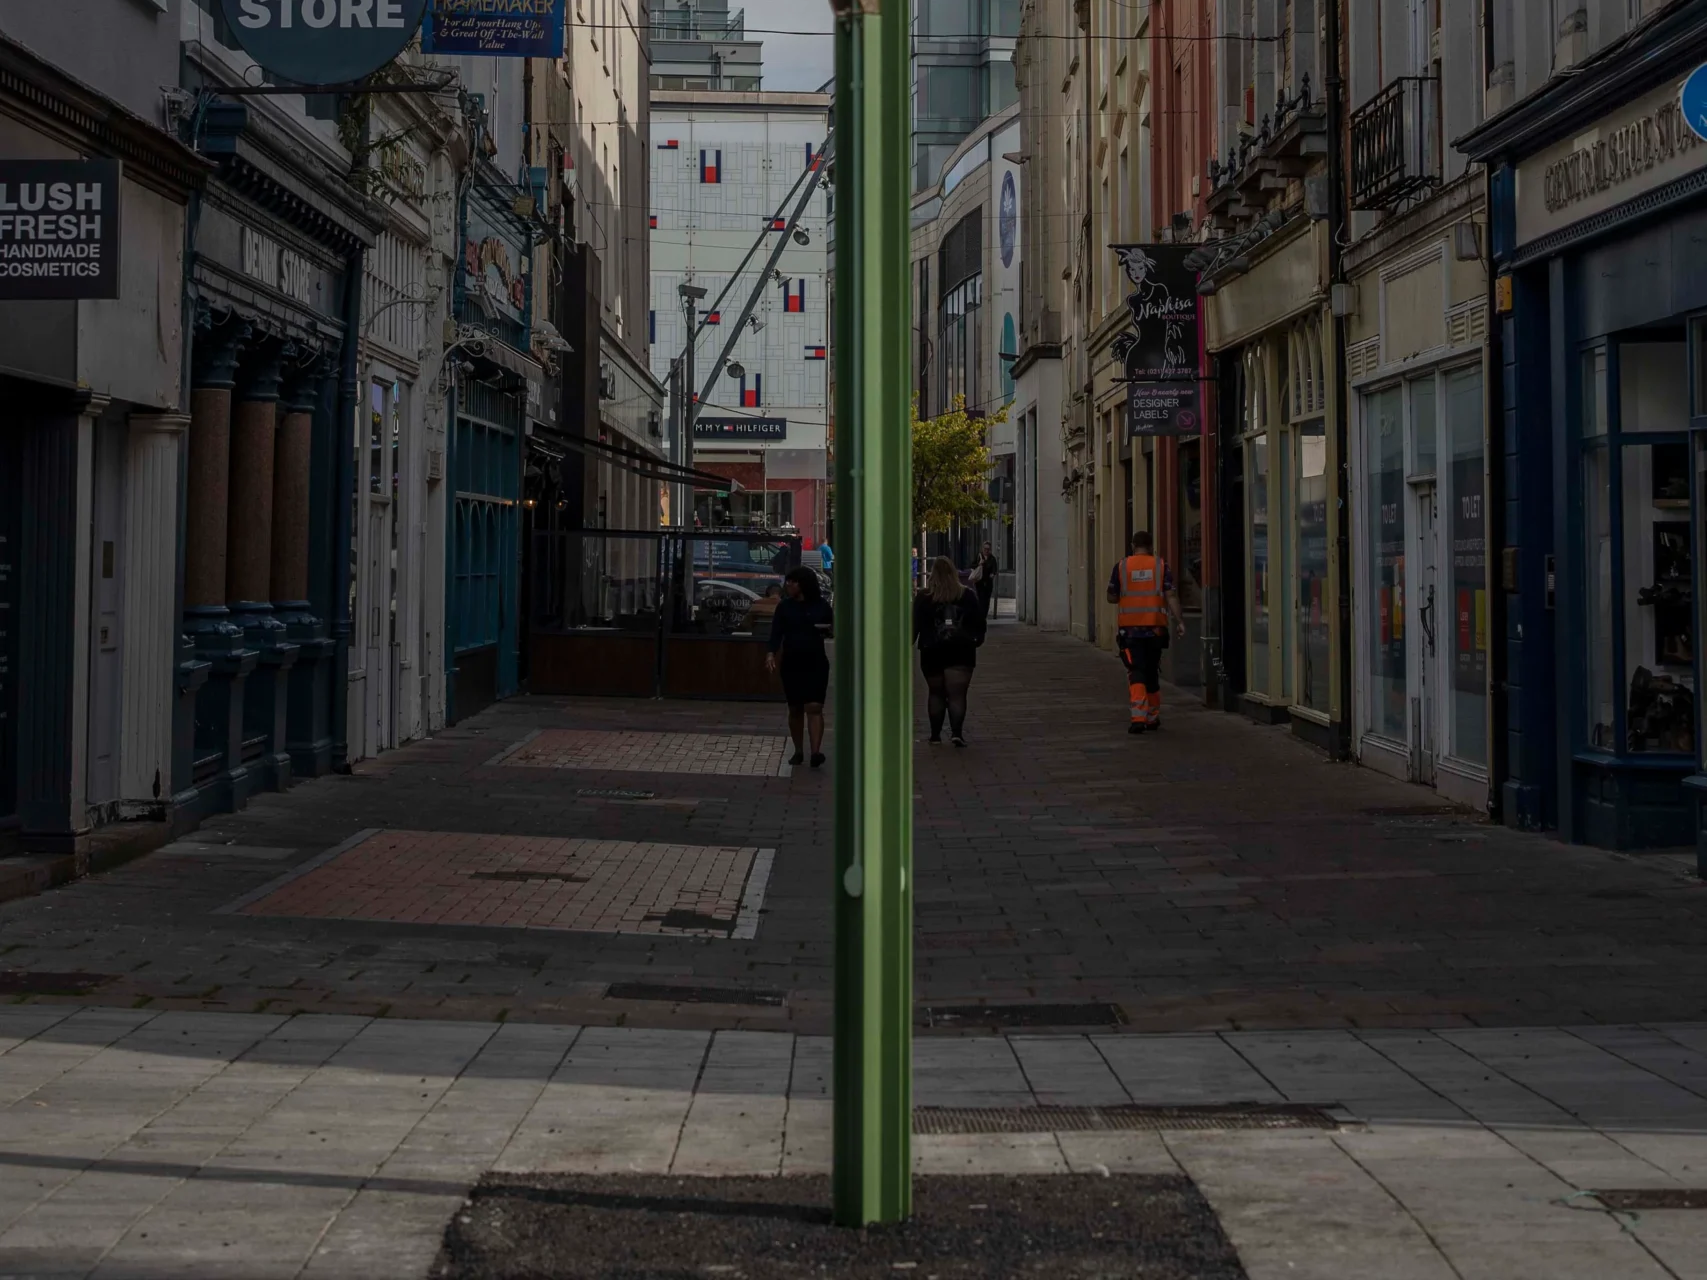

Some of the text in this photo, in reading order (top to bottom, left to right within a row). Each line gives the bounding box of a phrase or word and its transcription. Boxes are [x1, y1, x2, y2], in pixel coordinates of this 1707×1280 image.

[462, 18, 474, 27] all
[440, 28, 448, 37] &
[451, 28, 477, 38] Great
[478, 40, 506, 49] Value
[1653, 96, 1698, 163] STO
[0, 182, 102, 211] LUSH
[0, 214, 101, 240] FRESH
[0, 243, 100, 258] HANDMADE
[0, 262, 100, 277] COSMETICS
[243, 226, 310, 305] DENIM STORE
[1136, 296, 1194, 321] Naphisa
[1157, 388, 1179, 397] nearly
[1133, 399, 1179, 408] DESIGNER
[1133, 410, 1169, 419] LABELS
[695, 424, 781, 432] MMY HILFIGER
[1381, 503, 1397, 525] TO LET
[1461, 494, 1481, 519] TO LET
